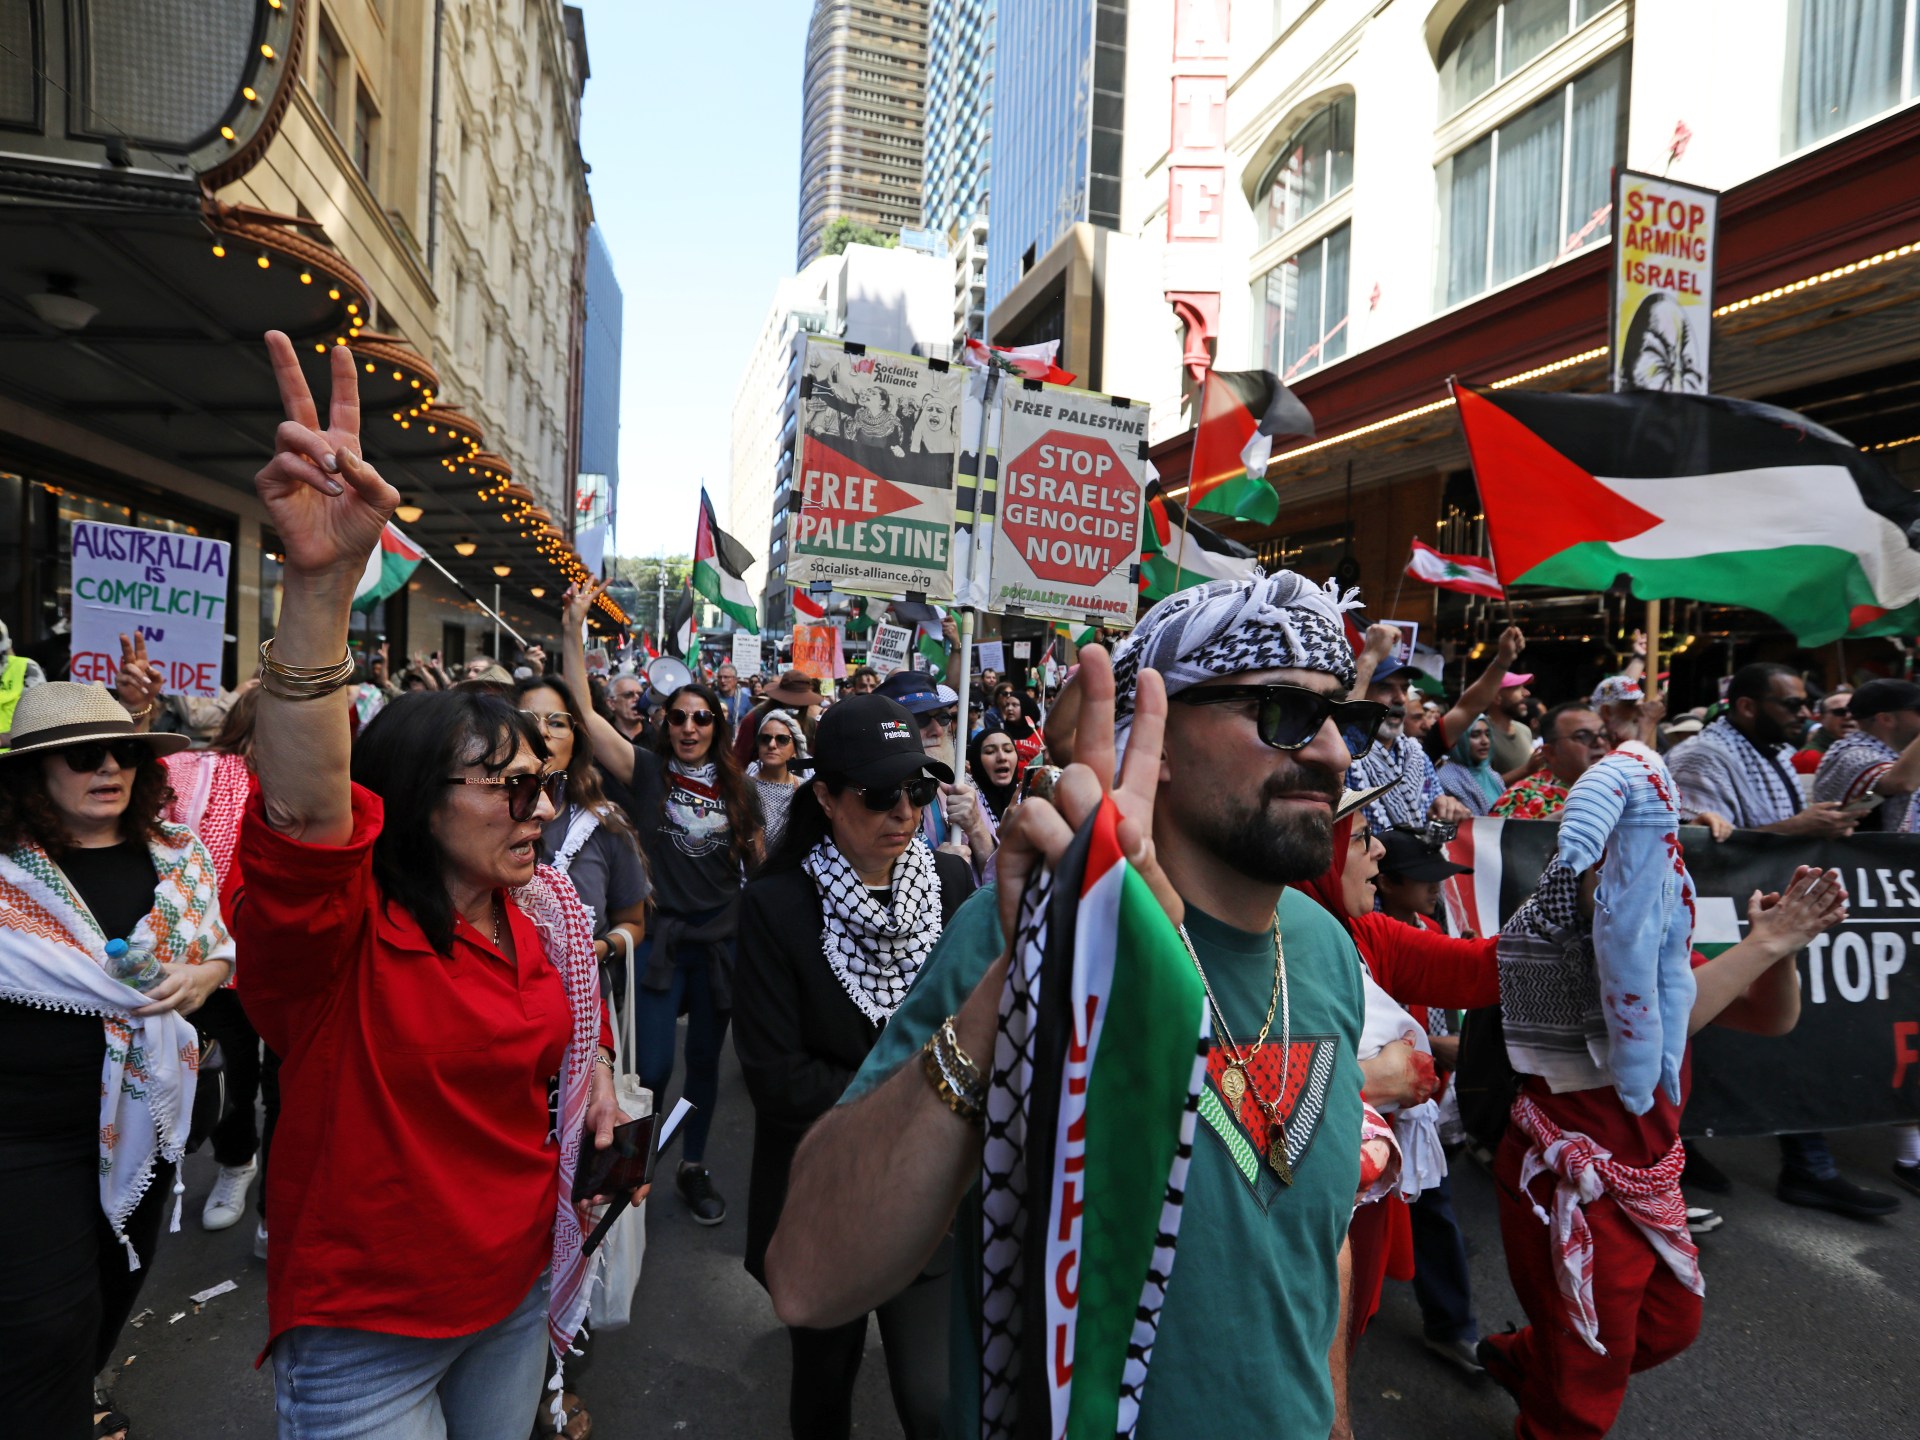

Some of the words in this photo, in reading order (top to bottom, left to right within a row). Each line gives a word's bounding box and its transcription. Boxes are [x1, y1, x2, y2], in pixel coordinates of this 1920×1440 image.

[1628, 190, 1705, 234] STOP
[1625, 223, 1706, 262] ARMING
[1626, 260, 1702, 296] ISRAEL
[873, 372, 918, 389] Alliance
[874, 363, 919, 379] Socialist
[1013, 400, 1053, 418] FREE
[1057, 408, 1146, 436] PALESTINE
[1038, 444, 1113, 478] STOP
[803, 470, 878, 513] FREE
[1008, 471, 1137, 515] ISRAEL'S
[800, 515, 947, 562] PALESTINE
[1005, 503, 1134, 542] GENOCIDE
[72, 523, 225, 577] AUSTRALIA
[1026, 536, 1111, 572] NOW!
[145, 566, 166, 584] IS
[810, 562, 931, 587] socialist-alliance.org
[75, 577, 225, 620] COMPLICIT
[1066, 594, 1128, 614] ALLIANCE
[875, 638, 898, 649] DIVEST
[878, 626, 907, 641] BOYCOTT
[872, 645, 904, 660] SANCTION
[70, 651, 217, 692] GENCIDE
[881, 721, 896, 730] Free
[884, 730, 911, 740] Palestine
[468, 777, 498, 785] CHANEL
[1796, 930, 1907, 1004] TOP
